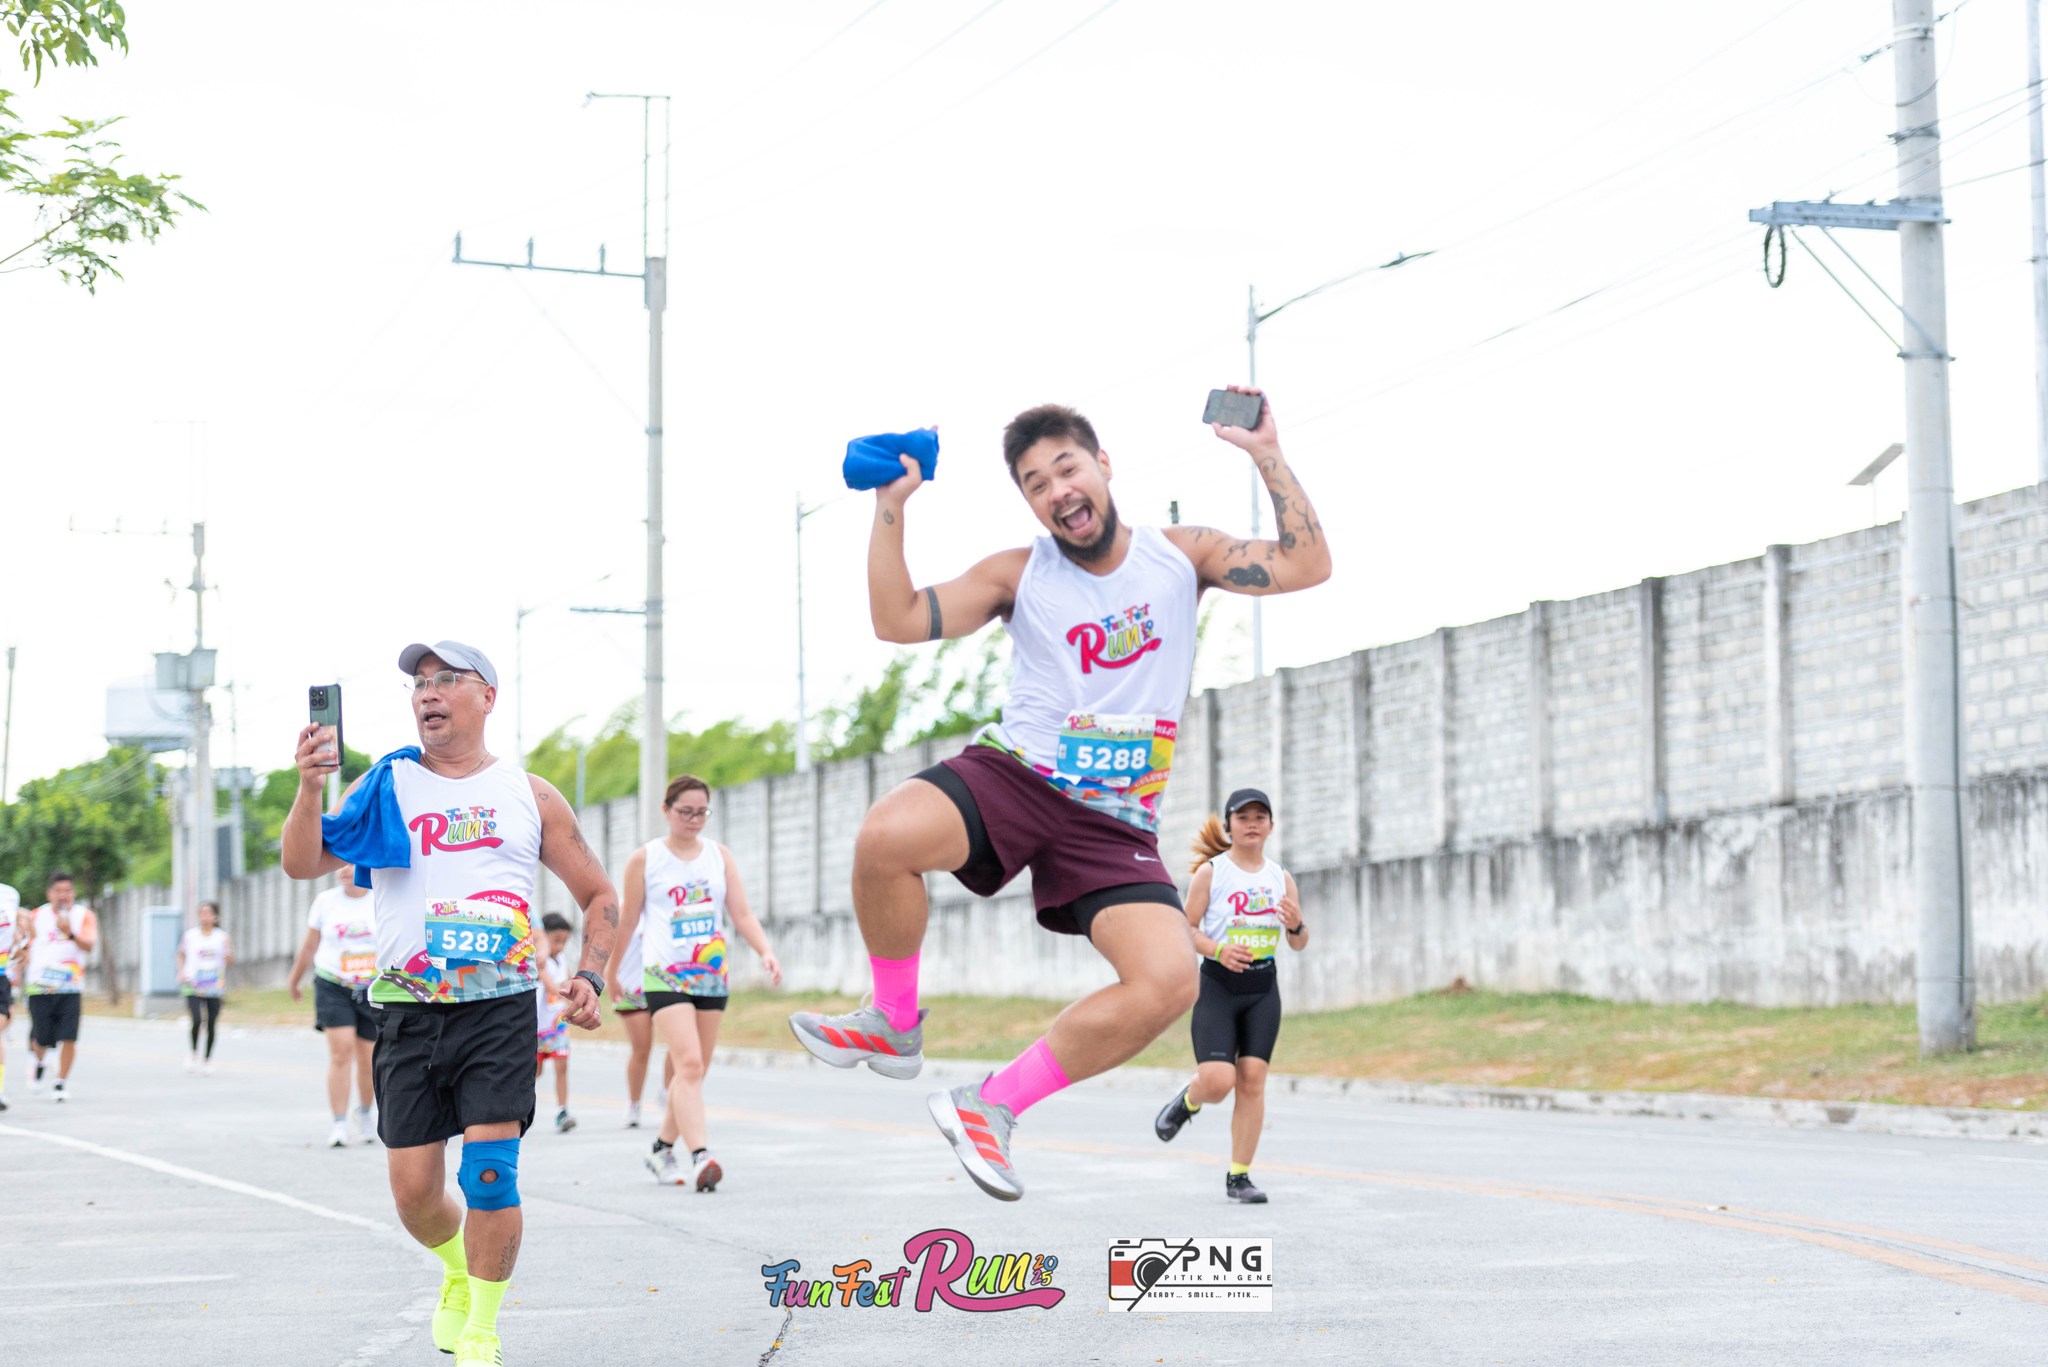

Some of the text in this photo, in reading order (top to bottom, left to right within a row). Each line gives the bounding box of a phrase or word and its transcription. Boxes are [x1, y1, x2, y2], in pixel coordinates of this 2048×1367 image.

[1066, 622, 1162, 674] Run
[1076, 745, 1146, 770] 5288
[408, 812, 504, 856] Run
[491, 894, 521, 909] SMILES
[442, 930, 502, 954] 5287
[1233, 934, 1277, 948] 10654
